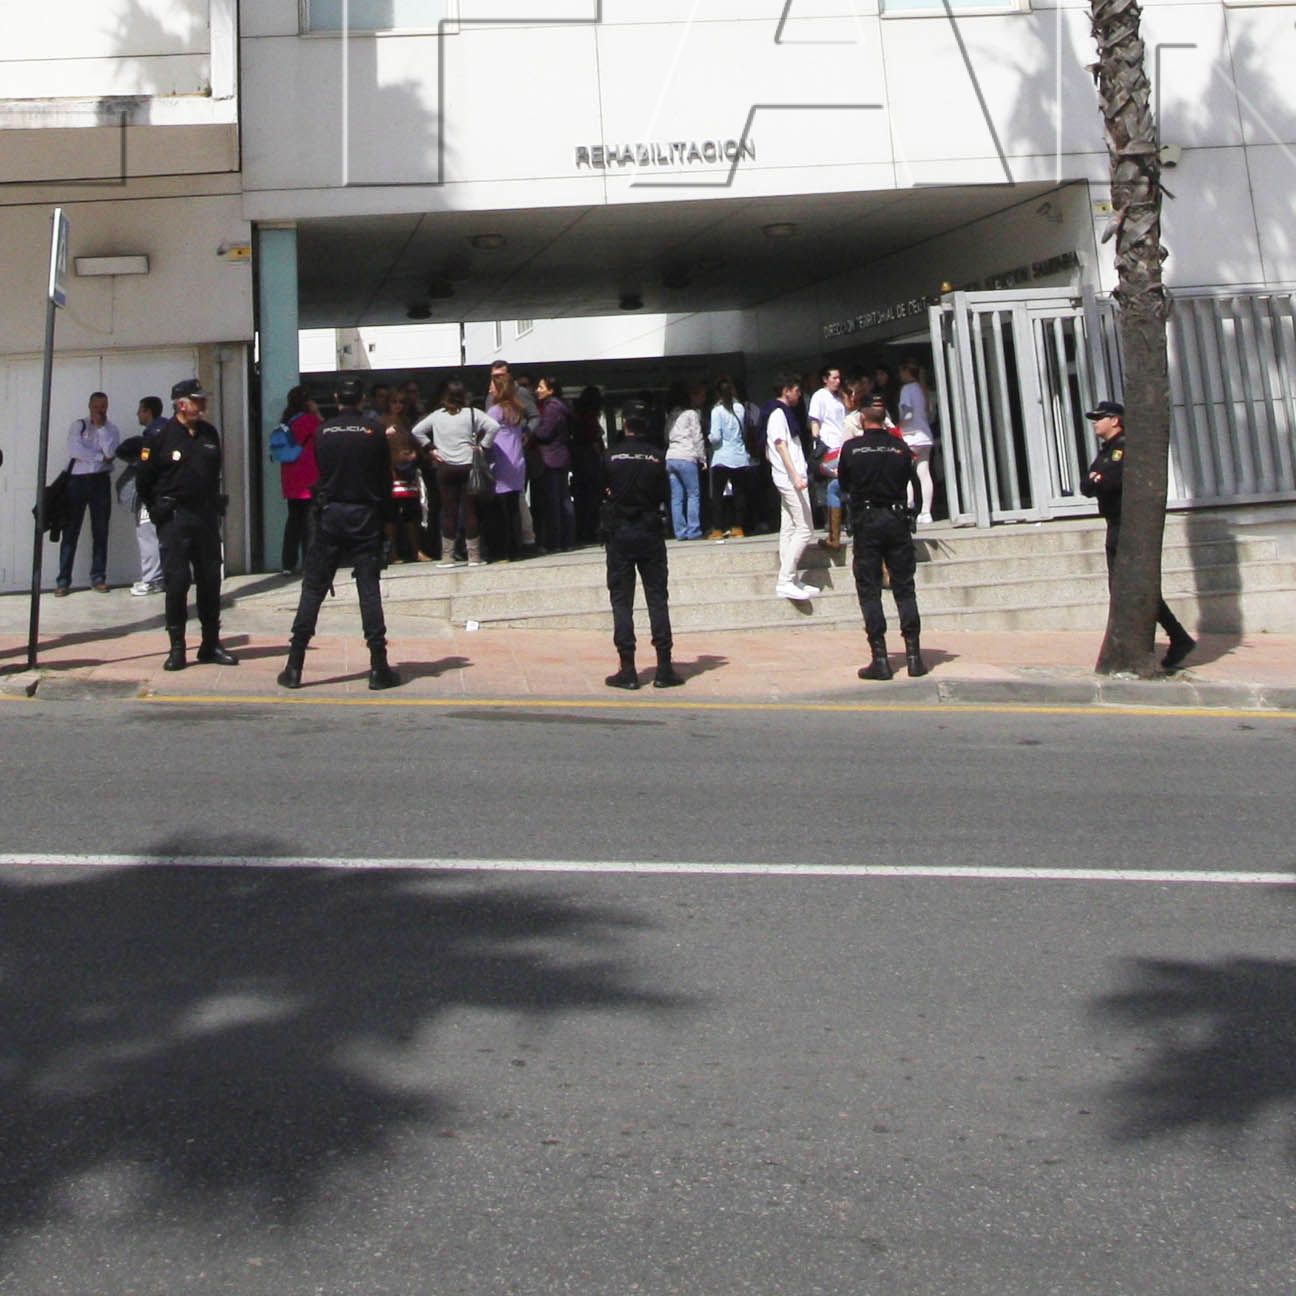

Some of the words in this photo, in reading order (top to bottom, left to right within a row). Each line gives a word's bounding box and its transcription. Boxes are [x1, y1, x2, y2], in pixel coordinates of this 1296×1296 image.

[575, 138, 757, 169] REHABILITACION
[322, 425, 369, 435] POLICIA
[852, 446, 898, 455] POLICIA
